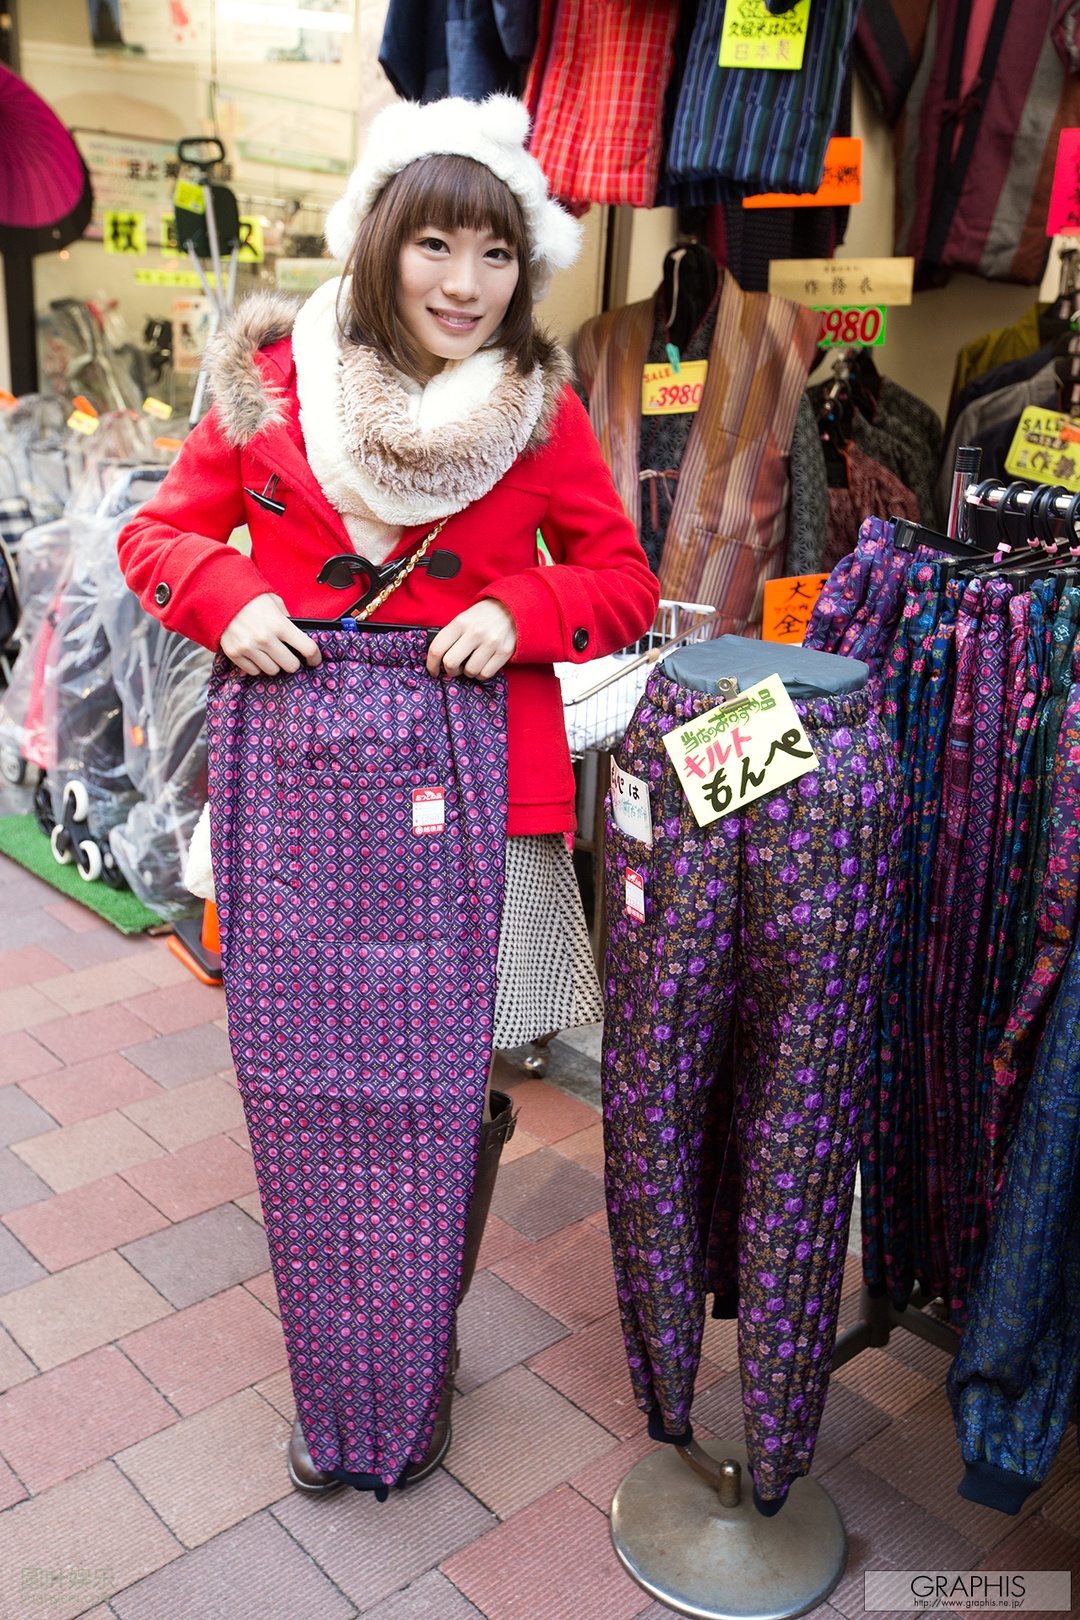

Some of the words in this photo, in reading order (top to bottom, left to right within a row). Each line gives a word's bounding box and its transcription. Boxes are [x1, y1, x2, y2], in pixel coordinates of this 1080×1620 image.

[735, 39, 791, 61] 日本製
[643, 367, 671, 384] SALE
[680, 688, 777, 755] 当店のおすすめ品
[683, 726, 753, 780] キルト
[701, 728, 814, 813] もんぺ
